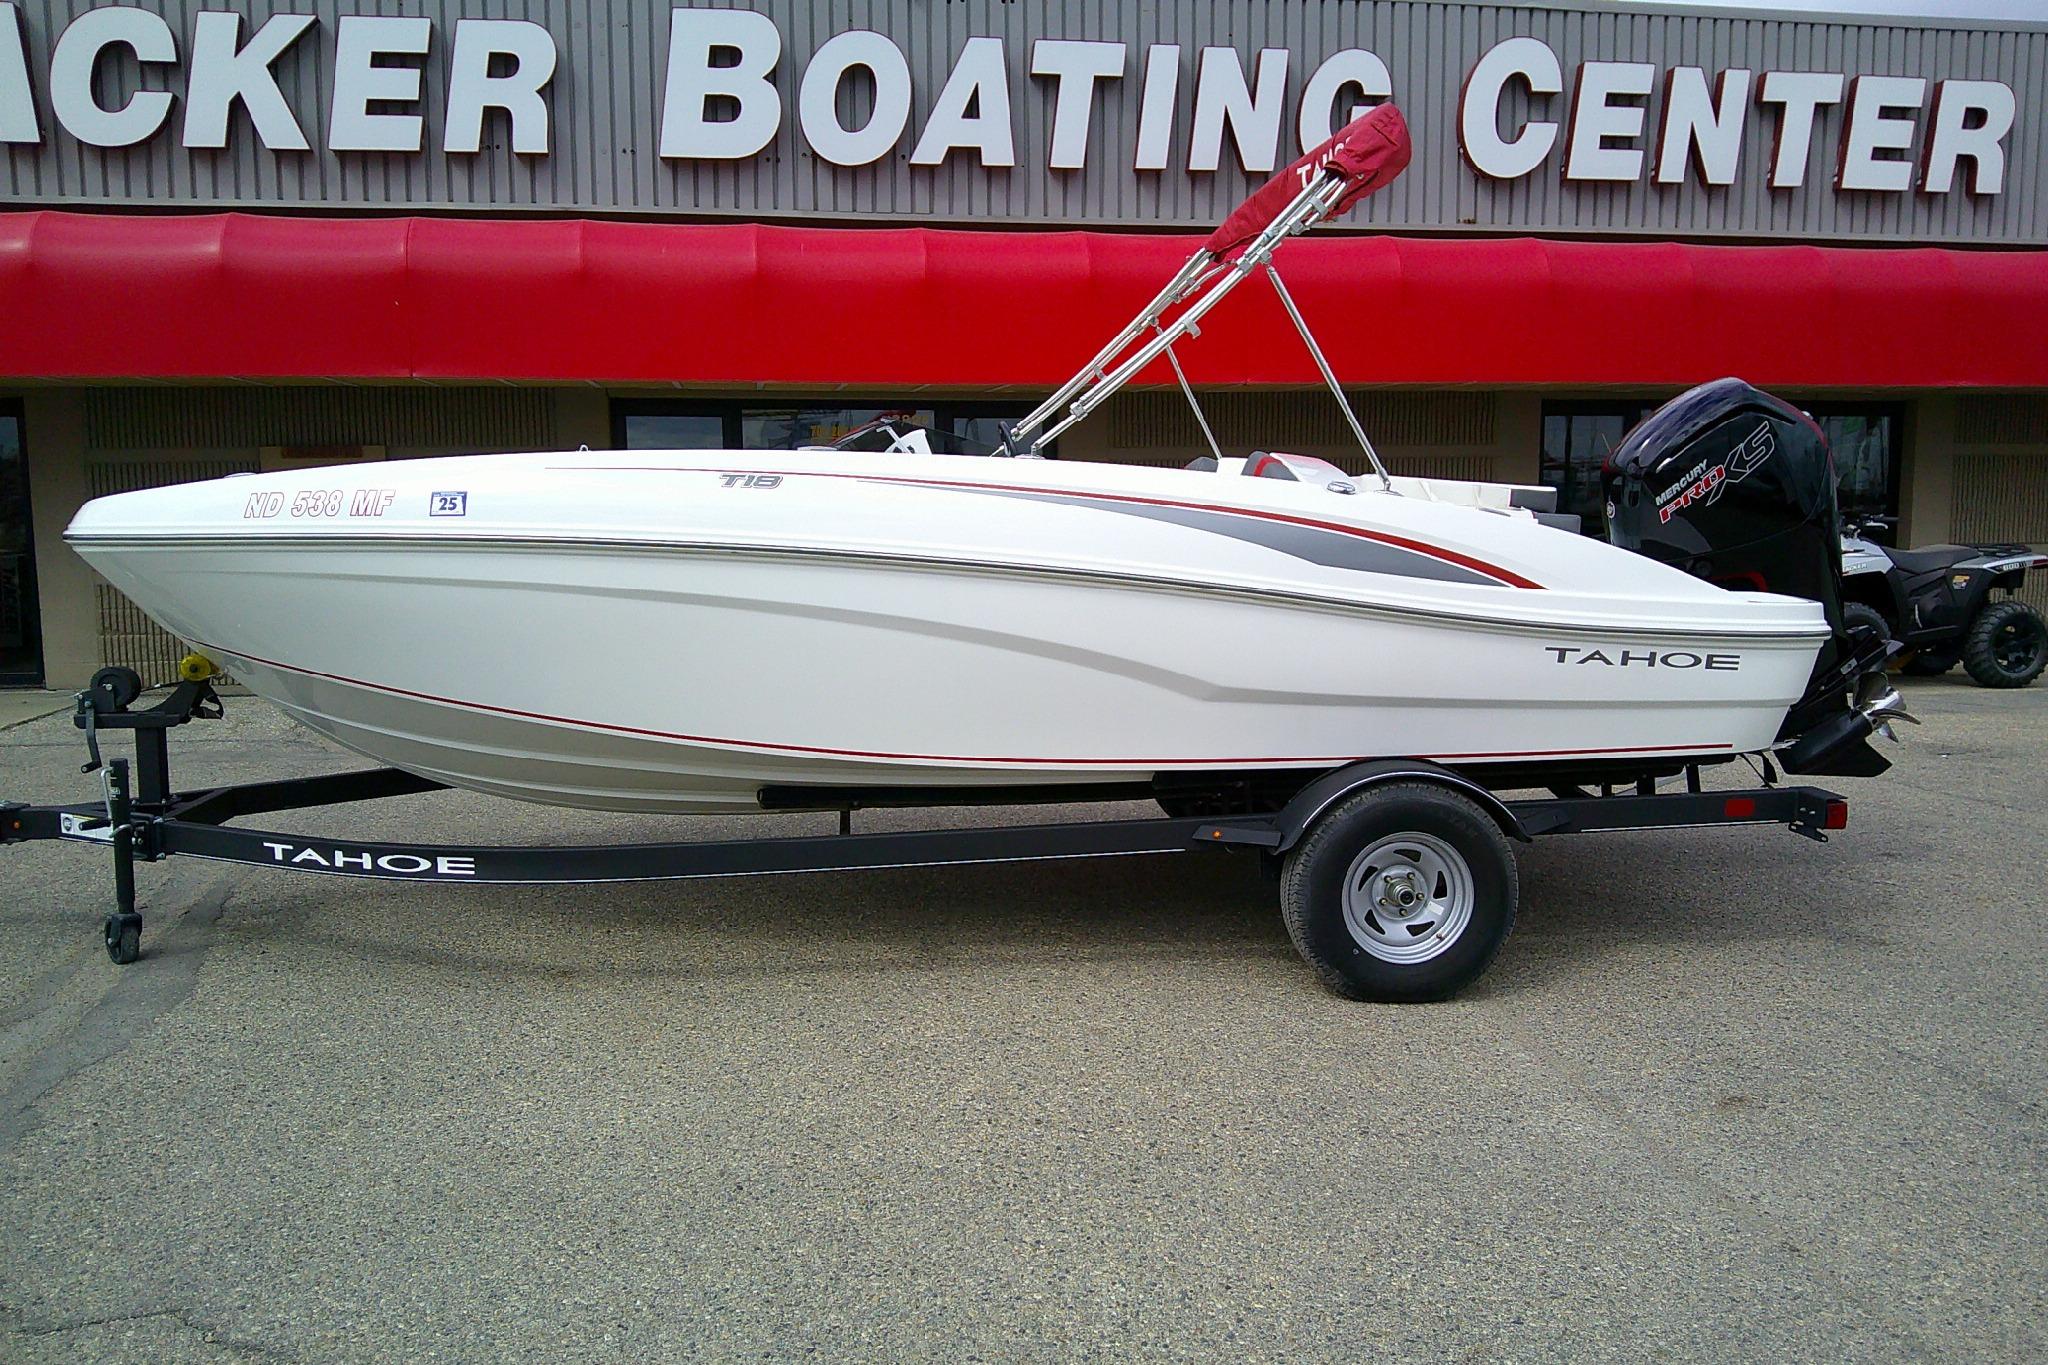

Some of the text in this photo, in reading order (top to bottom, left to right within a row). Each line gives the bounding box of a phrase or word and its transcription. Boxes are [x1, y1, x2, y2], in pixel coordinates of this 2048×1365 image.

[660, 8, 1393, 172] BOATING
[1459, 36, 2016, 195] CENTER
[719, 474, 783, 490] T18
[1655, 459, 1707, 506] MERCURY
[1659, 464, 1726, 524] PRO
[244, 489, 396, 518] ND 538 MF
[438, 497, 458, 511] 25
[1544, 646, 1741, 671] TAHOE
[262, 841, 476, 875] TAHOE
